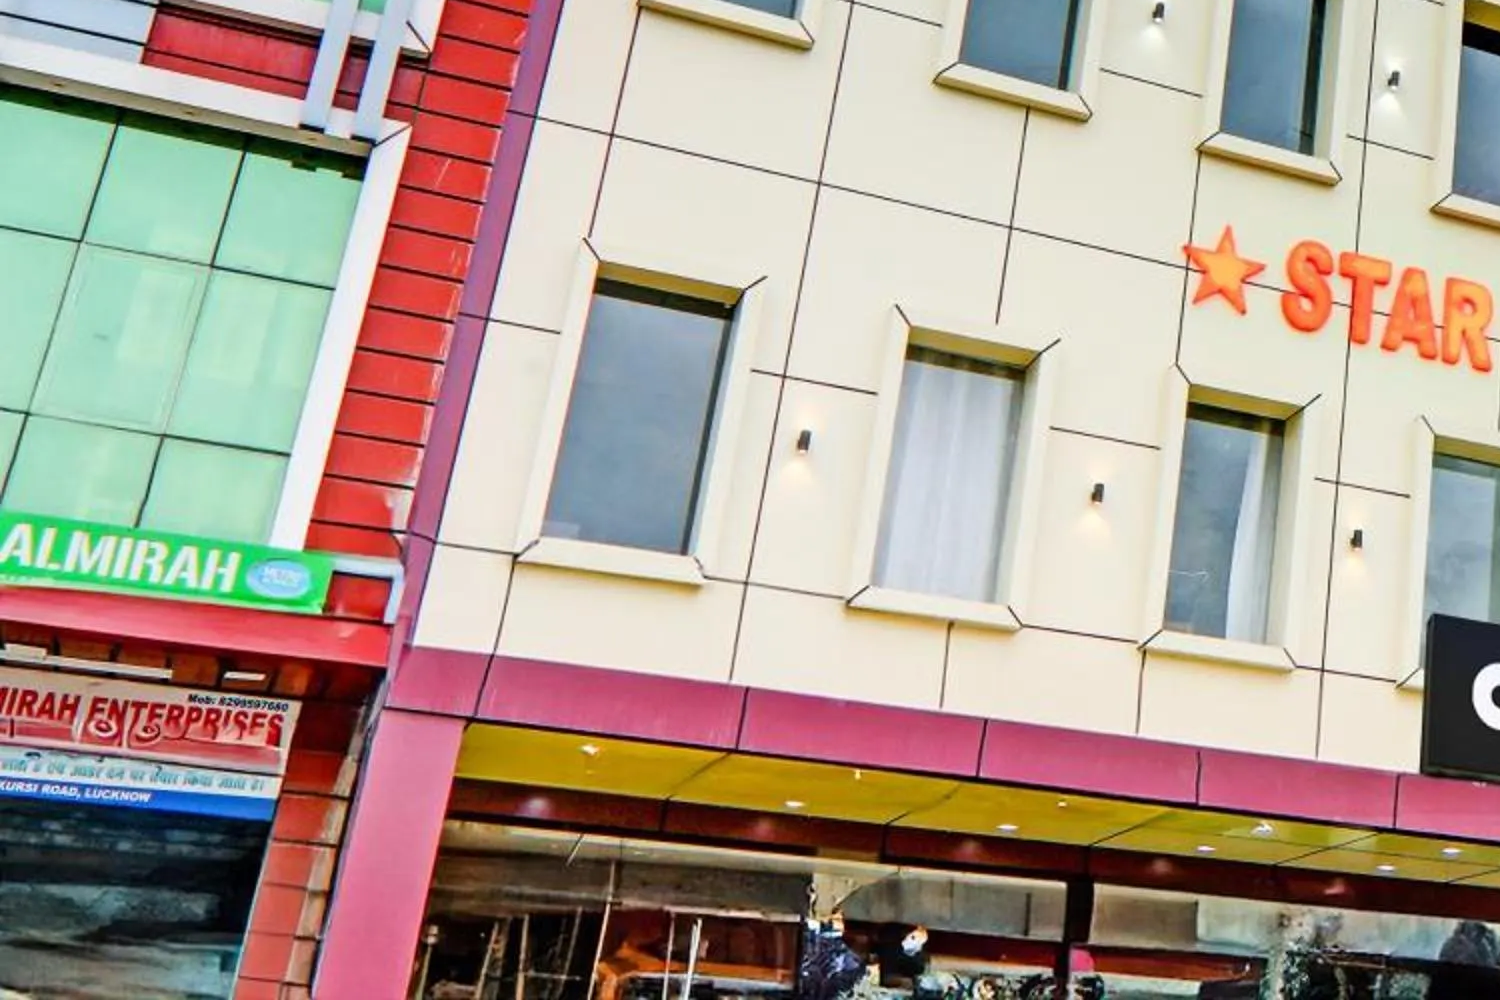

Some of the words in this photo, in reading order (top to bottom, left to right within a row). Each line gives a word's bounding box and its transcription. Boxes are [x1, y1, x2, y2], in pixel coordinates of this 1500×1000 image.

[1281, 240, 1493, 372] STAR
[0, 523, 242, 593] ALMIRAH
[87, 696, 285, 745] ENTERPRISES
[84, 787, 152, 803] LUCKNOW
